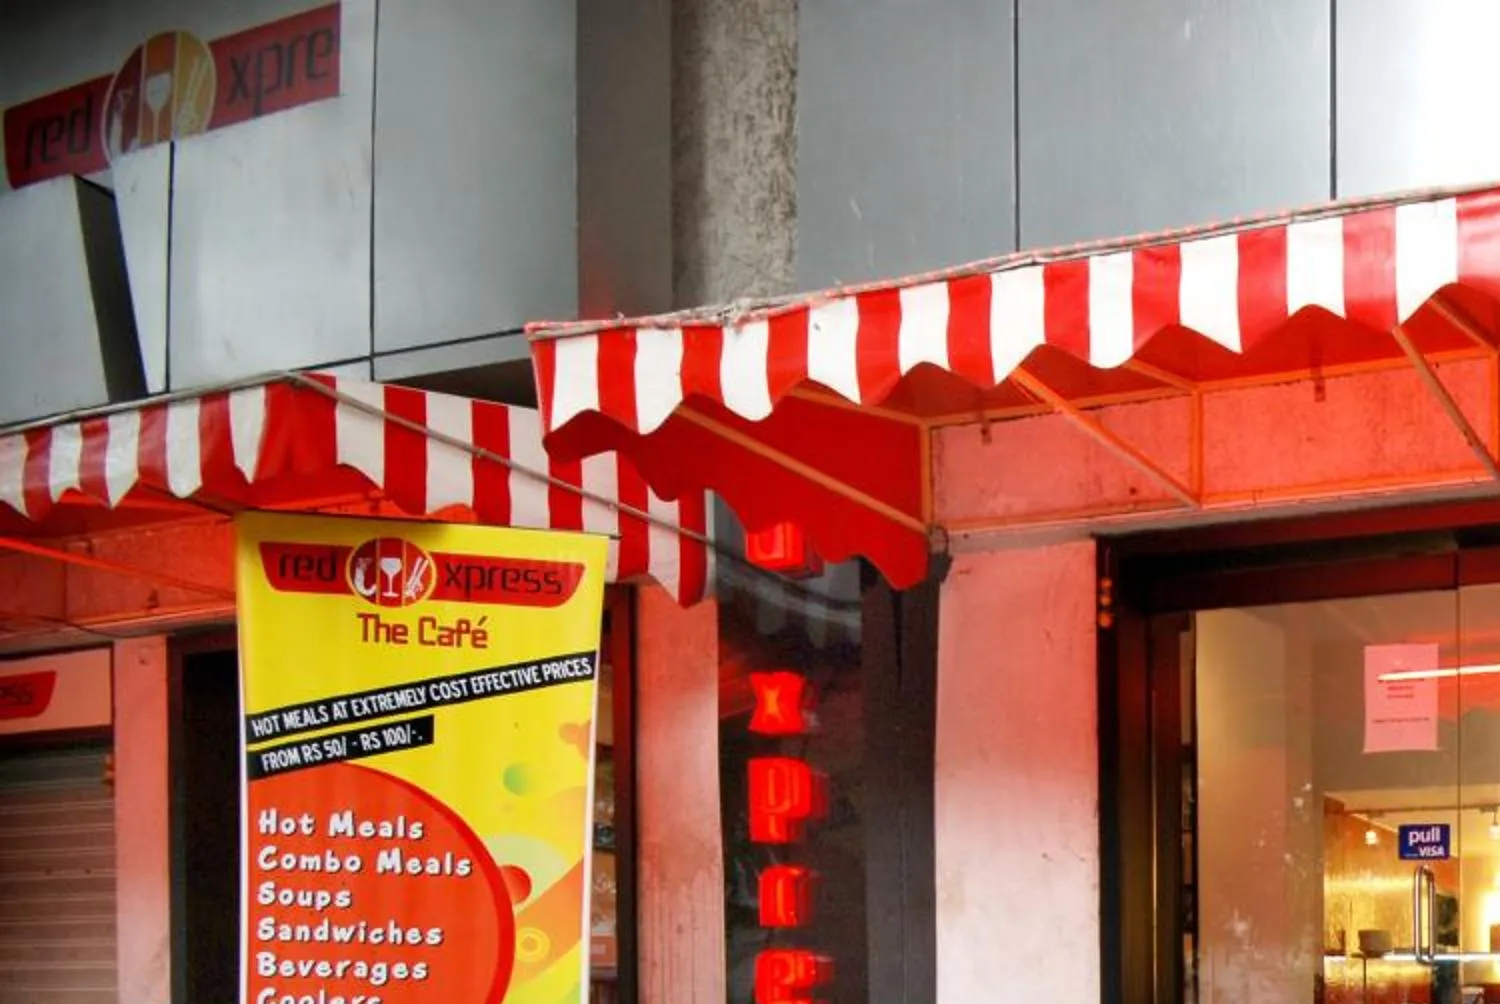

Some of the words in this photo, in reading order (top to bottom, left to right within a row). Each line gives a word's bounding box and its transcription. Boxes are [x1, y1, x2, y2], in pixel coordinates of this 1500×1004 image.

[24, 93, 93, 170] red
[278, 551, 338, 583] red
[445, 562, 563, 598] xpress
[358, 612, 409, 645] The
[418, 616, 489, 649] Café
[252, 714, 281, 737] HOT
[282, 704, 330, 729] MEALS
[333, 700, 349, 720] AT
[351, 685, 427, 717] EXTREMELY
[429, 678, 468, 702] COST
[471, 665, 542, 694] EFFECTIVE
[541, 656, 593, 681] PRICES
[261, 747, 301, 772] FROM
[302, 743, 323, 763] RS
[360, 731, 382, 751] RS
[258, 808, 315, 836] Hot
[328, 811, 425, 840] Meals
[1408, 826, 1441, 847] pull
[257, 845, 363, 873] Combo
[376, 848, 473, 876] Meals
[1418, 845, 1445, 857] VISA
[257, 881, 352, 911] Soups
[256, 916, 445, 946] Sandwiches
[256, 952, 429, 985] Beverages
